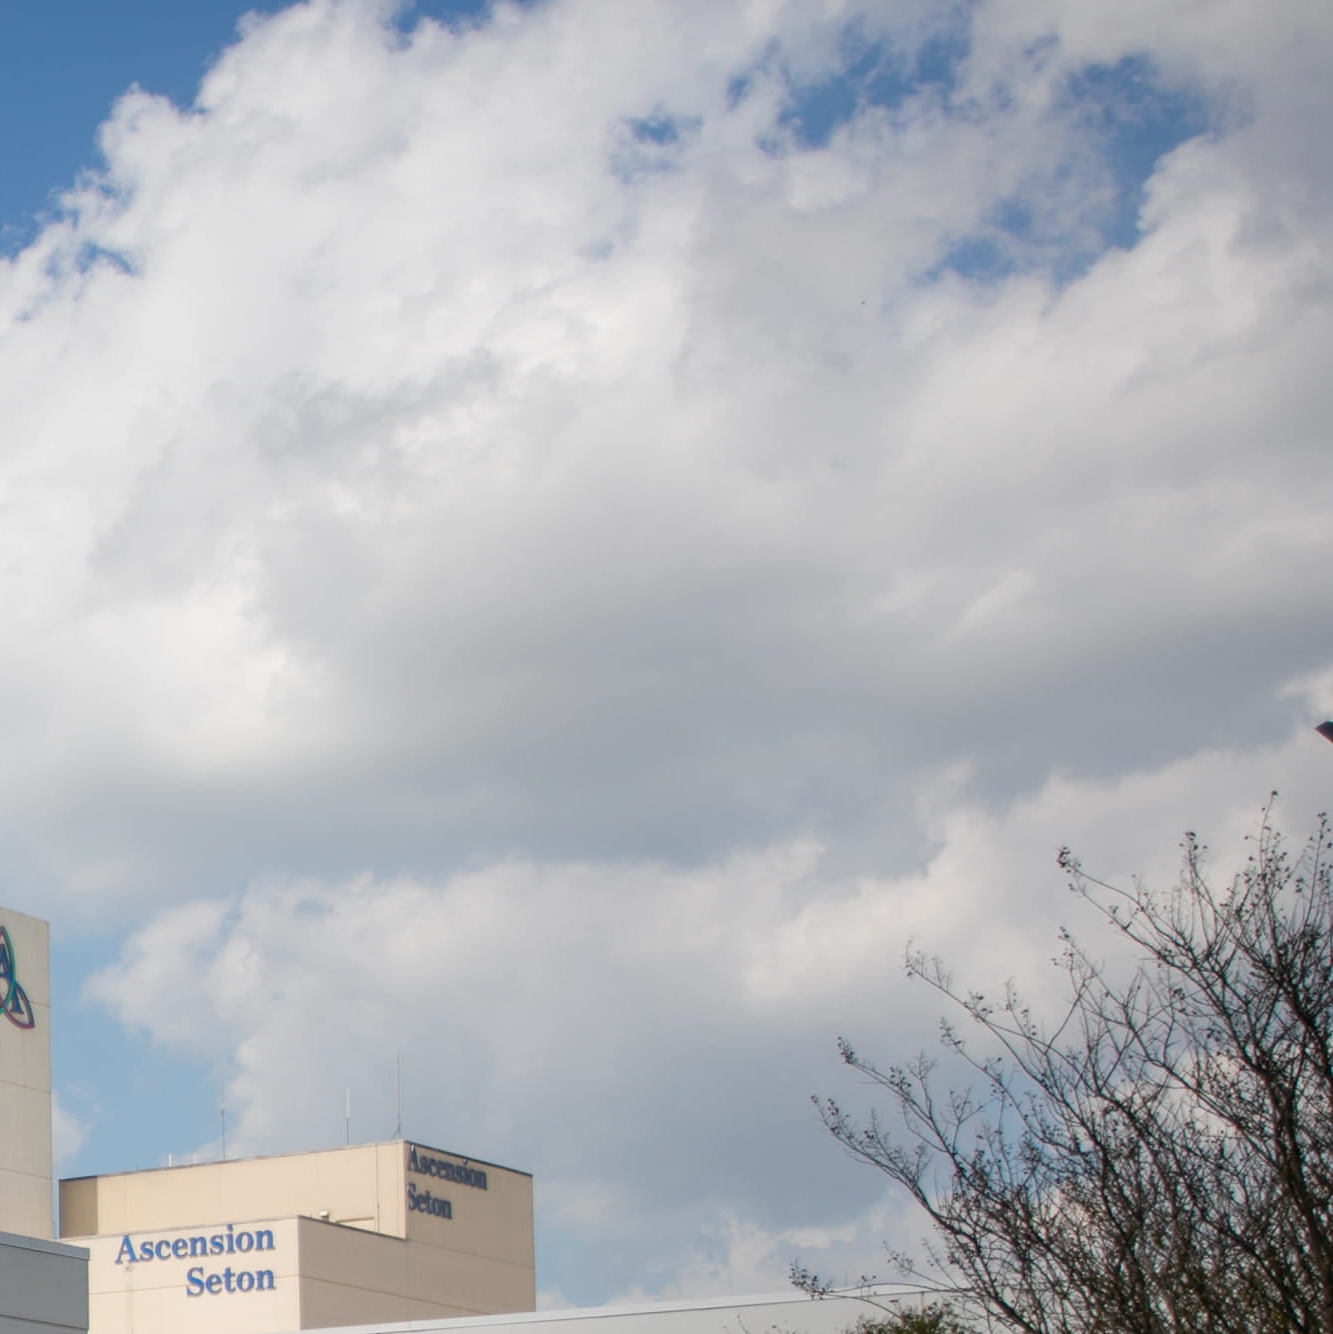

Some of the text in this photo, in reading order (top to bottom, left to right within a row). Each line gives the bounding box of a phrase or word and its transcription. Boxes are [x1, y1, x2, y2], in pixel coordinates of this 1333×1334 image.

[407, 1147, 488, 1191] Ascension
[407, 1182, 453, 1220] Seton
[114, 1223, 276, 1265] Ascension
[186, 1266, 277, 1298] Seton
